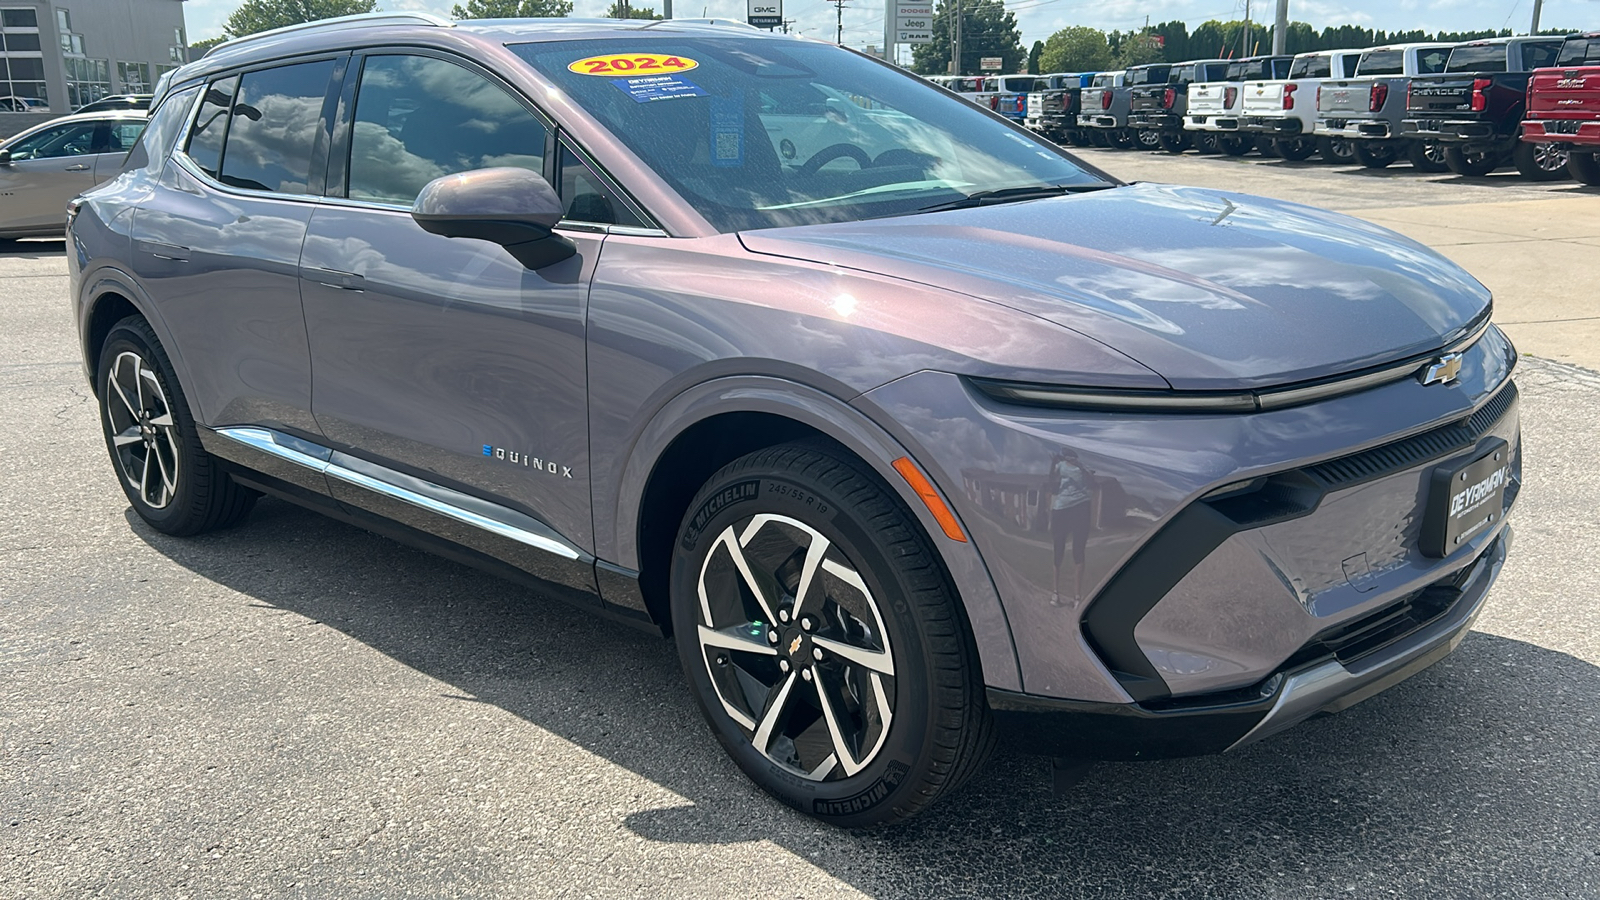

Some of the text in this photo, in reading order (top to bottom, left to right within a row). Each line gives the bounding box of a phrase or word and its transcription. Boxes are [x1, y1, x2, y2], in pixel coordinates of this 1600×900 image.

[904, 19, 926, 28] Jeep
[584, 57, 687, 73] 2024
[1412, 88, 1467, 96] CHEVROLET
[482, 444, 573, 479] EQUINOX
[695, 482, 756, 527] MICHELIN
[768, 483, 829, 514] 245/55 R 19
[1450, 466, 1506, 517] DEYARMAN
[816, 785, 888, 815] MICHELIN
